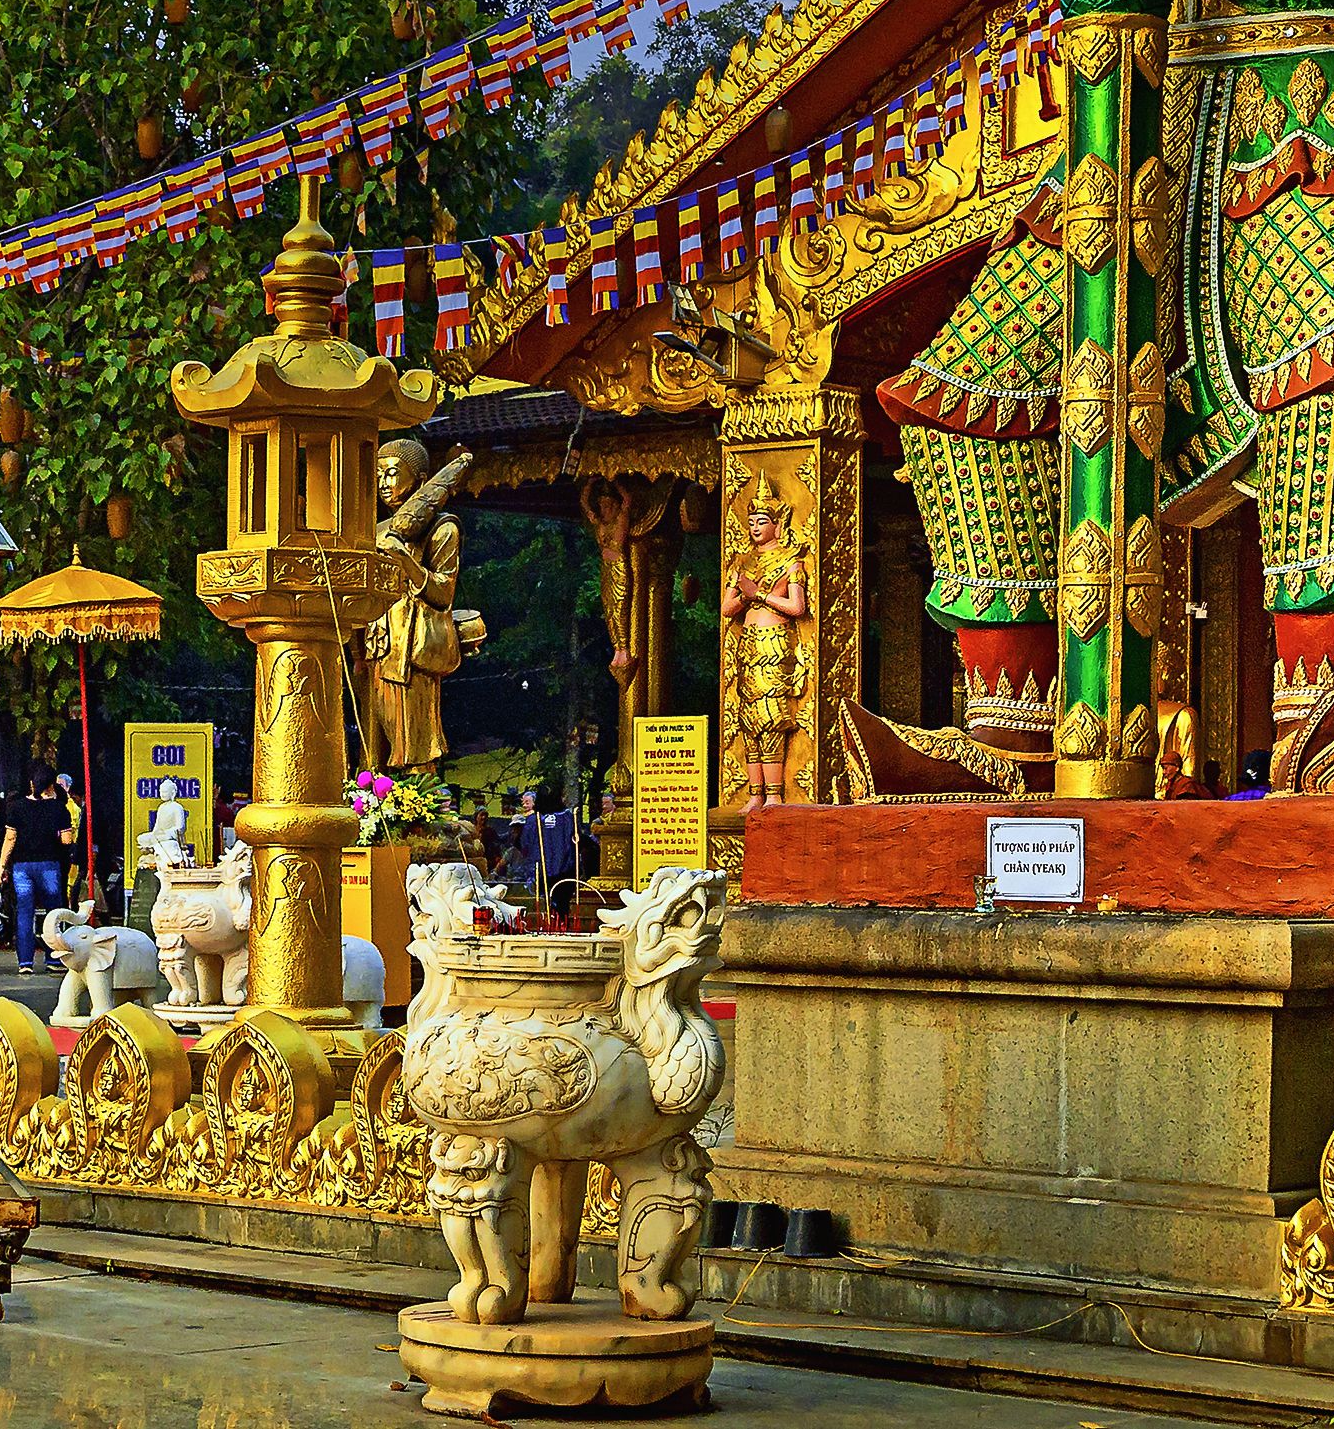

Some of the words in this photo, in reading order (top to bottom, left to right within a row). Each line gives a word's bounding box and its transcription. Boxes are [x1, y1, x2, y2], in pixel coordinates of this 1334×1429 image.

[152, 744, 186, 767] COI
[995, 842, 1030, 855] TƯỢNG
[1032, 840, 1047, 855] HỘ
[1049, 840, 1076, 853] PHÁP
[1032, 863, 1066, 876] (YEAK)
